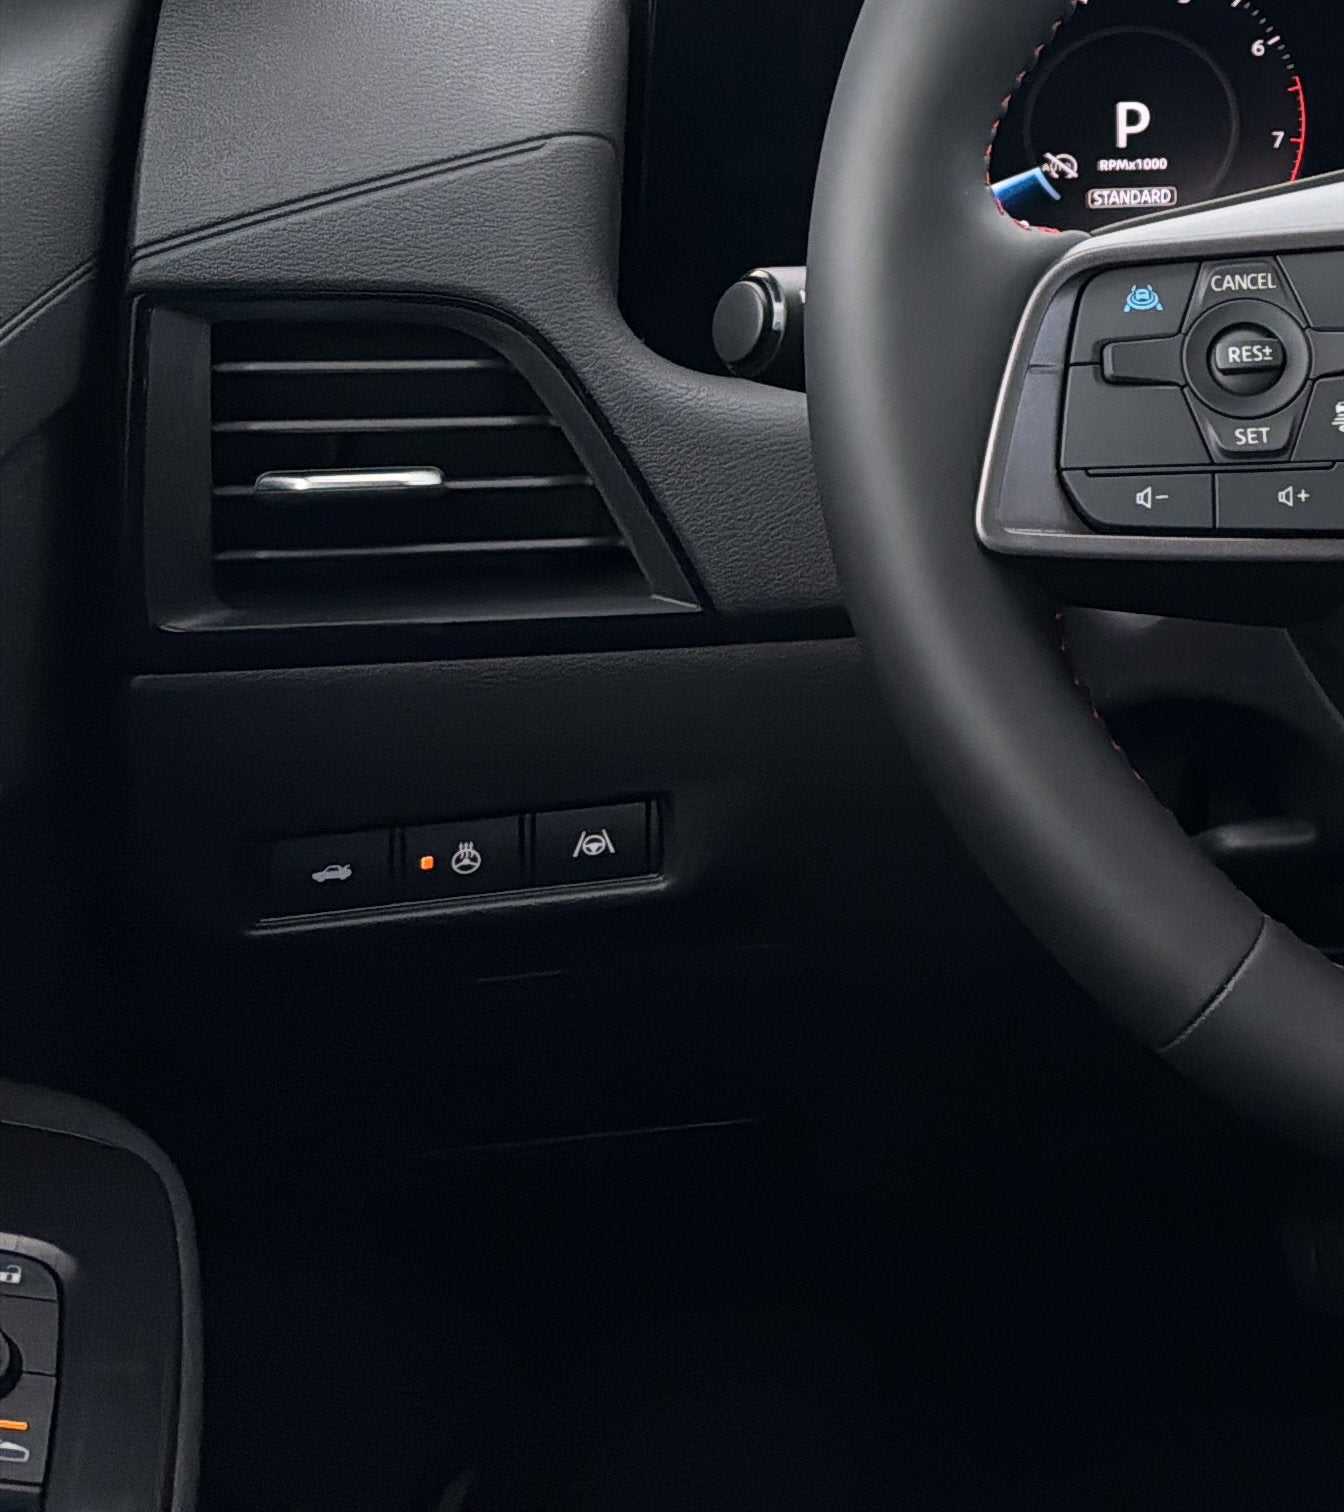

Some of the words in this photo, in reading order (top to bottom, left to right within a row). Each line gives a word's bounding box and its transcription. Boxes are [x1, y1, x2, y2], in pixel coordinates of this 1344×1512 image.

[1251, 39, 1265, 57] 6
[1115, 100, 1152, 149] P
[1271, 130, 1285, 148] 7
[1097, 157, 1168, 171] RPMx1000
[1092, 188, 1172, 206] STANDARD
[1211, 272, 1277, 292] CANCEL
[1234, 428, 1271, 445] SET
